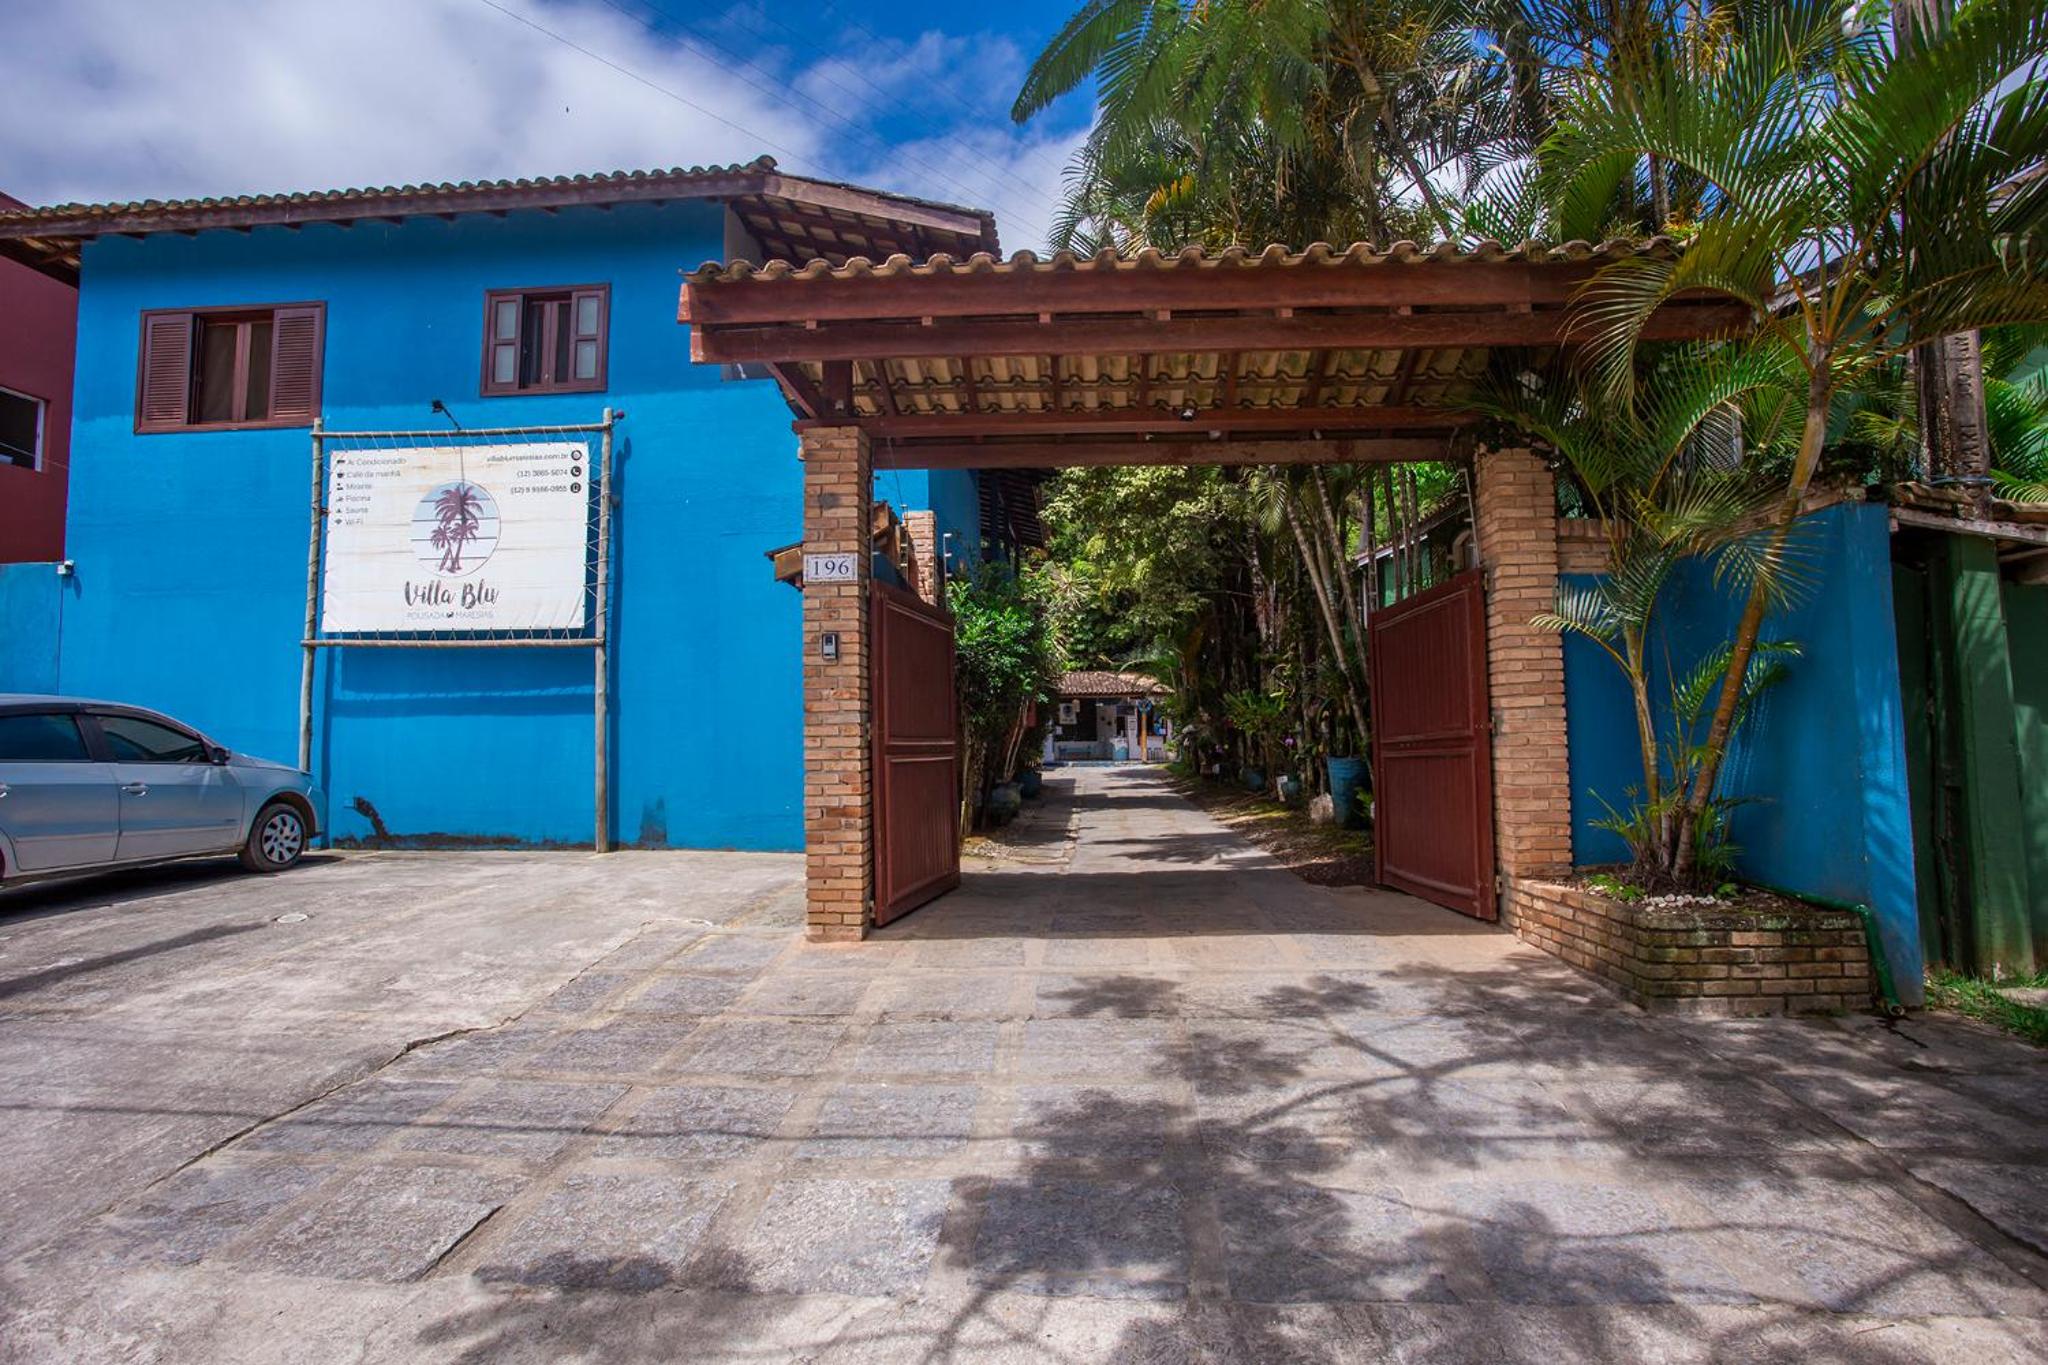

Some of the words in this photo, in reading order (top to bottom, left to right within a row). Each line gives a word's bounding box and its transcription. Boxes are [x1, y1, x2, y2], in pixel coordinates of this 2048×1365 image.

[356, 457, 406, 465] Condicionado
[365, 470, 374, 478] da
[345, 495, 371, 503] Piscina
[814, 560, 849, 575] 196
[404, 580, 456, 607] Villa
[461, 578, 500, 610] Blu
